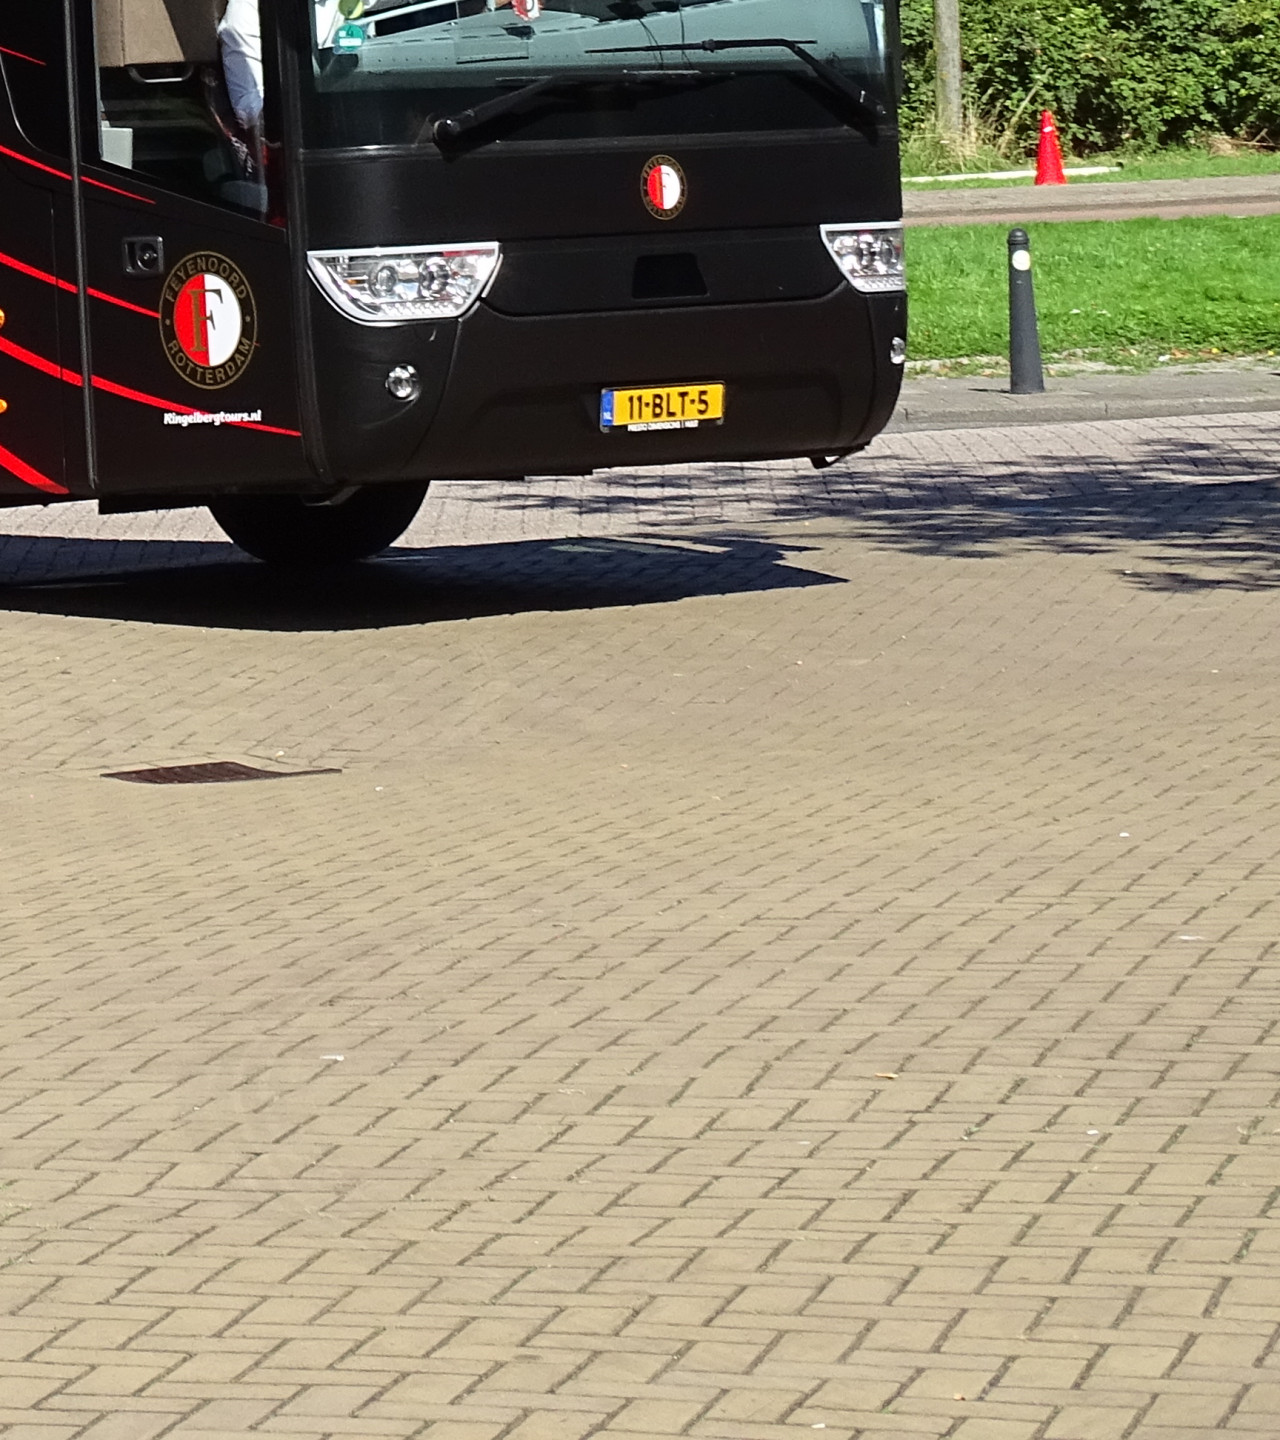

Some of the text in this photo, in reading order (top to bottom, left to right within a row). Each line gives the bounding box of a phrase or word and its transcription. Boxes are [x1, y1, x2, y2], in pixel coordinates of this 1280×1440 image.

[165, 256, 248, 303] FEYENOORD
[167, 337, 251, 384] ROTTERDAM
[163, 409, 262, 427] Kingelbergtours.nl
[628, 390, 709, 420] 11-BLT-5
